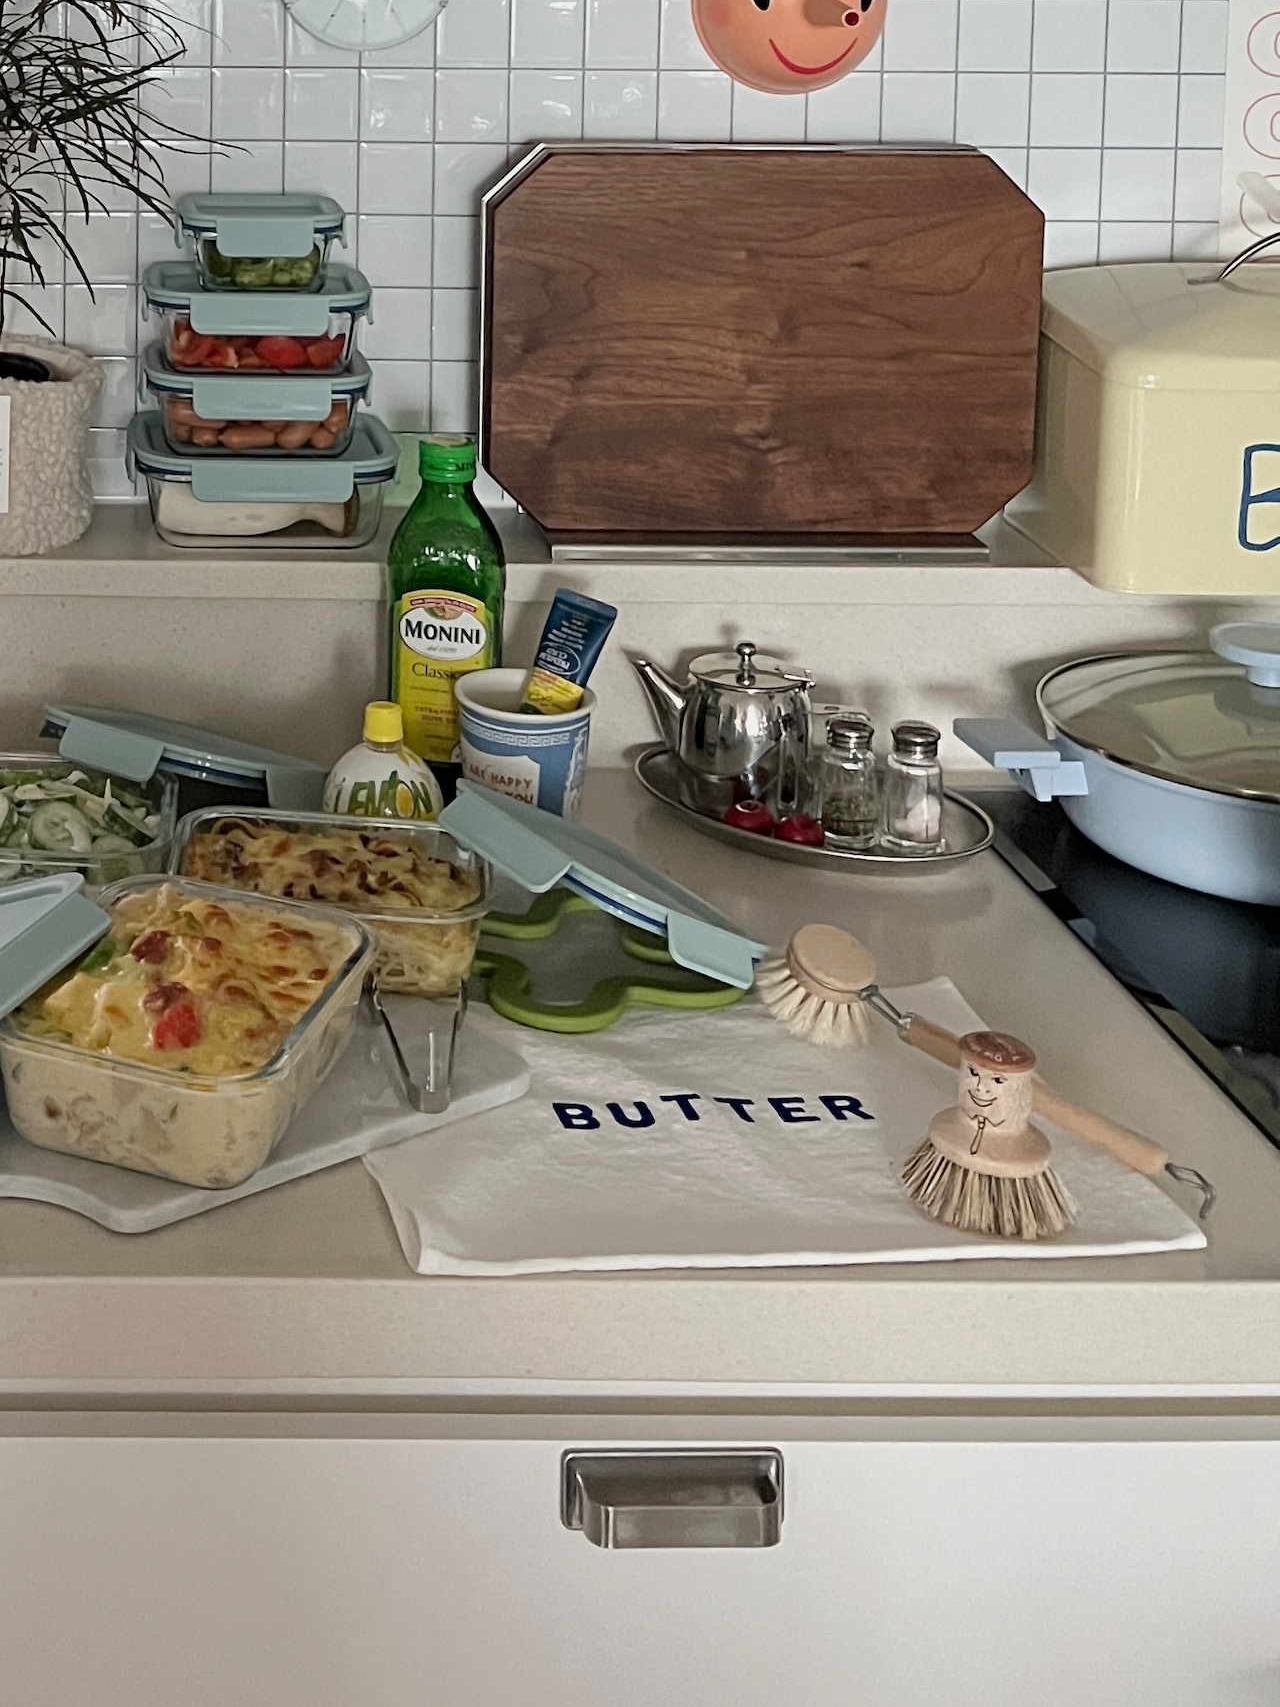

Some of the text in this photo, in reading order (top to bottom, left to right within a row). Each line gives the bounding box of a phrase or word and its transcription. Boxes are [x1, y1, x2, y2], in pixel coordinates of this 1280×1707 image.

[404, 618, 480, 645] MONINI
[491, 773, 533, 789] HAPPY
[551, 1093, 875, 1130] BUTTER
